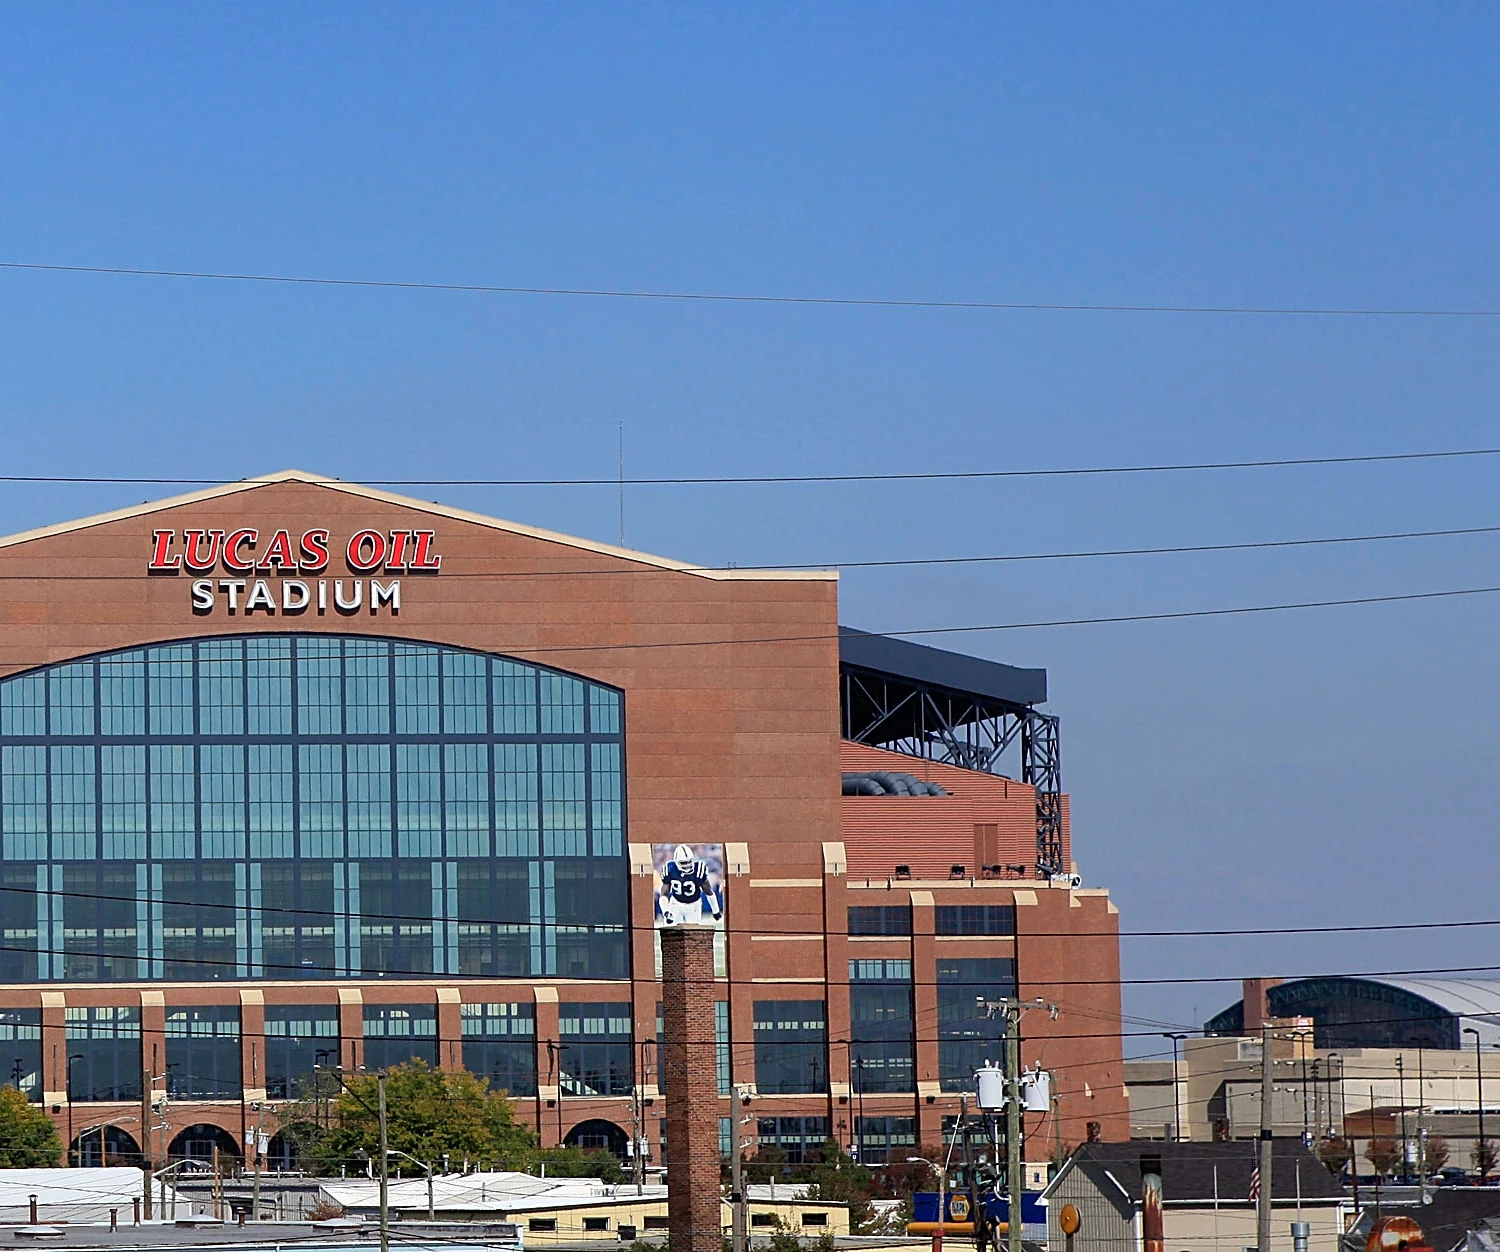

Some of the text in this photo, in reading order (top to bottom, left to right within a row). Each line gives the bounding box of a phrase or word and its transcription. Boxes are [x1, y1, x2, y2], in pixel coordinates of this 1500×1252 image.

[148, 527, 442, 570] LUCAS OIL
[192, 579, 401, 609] STADIUM
[670, 879, 696, 897] 93
